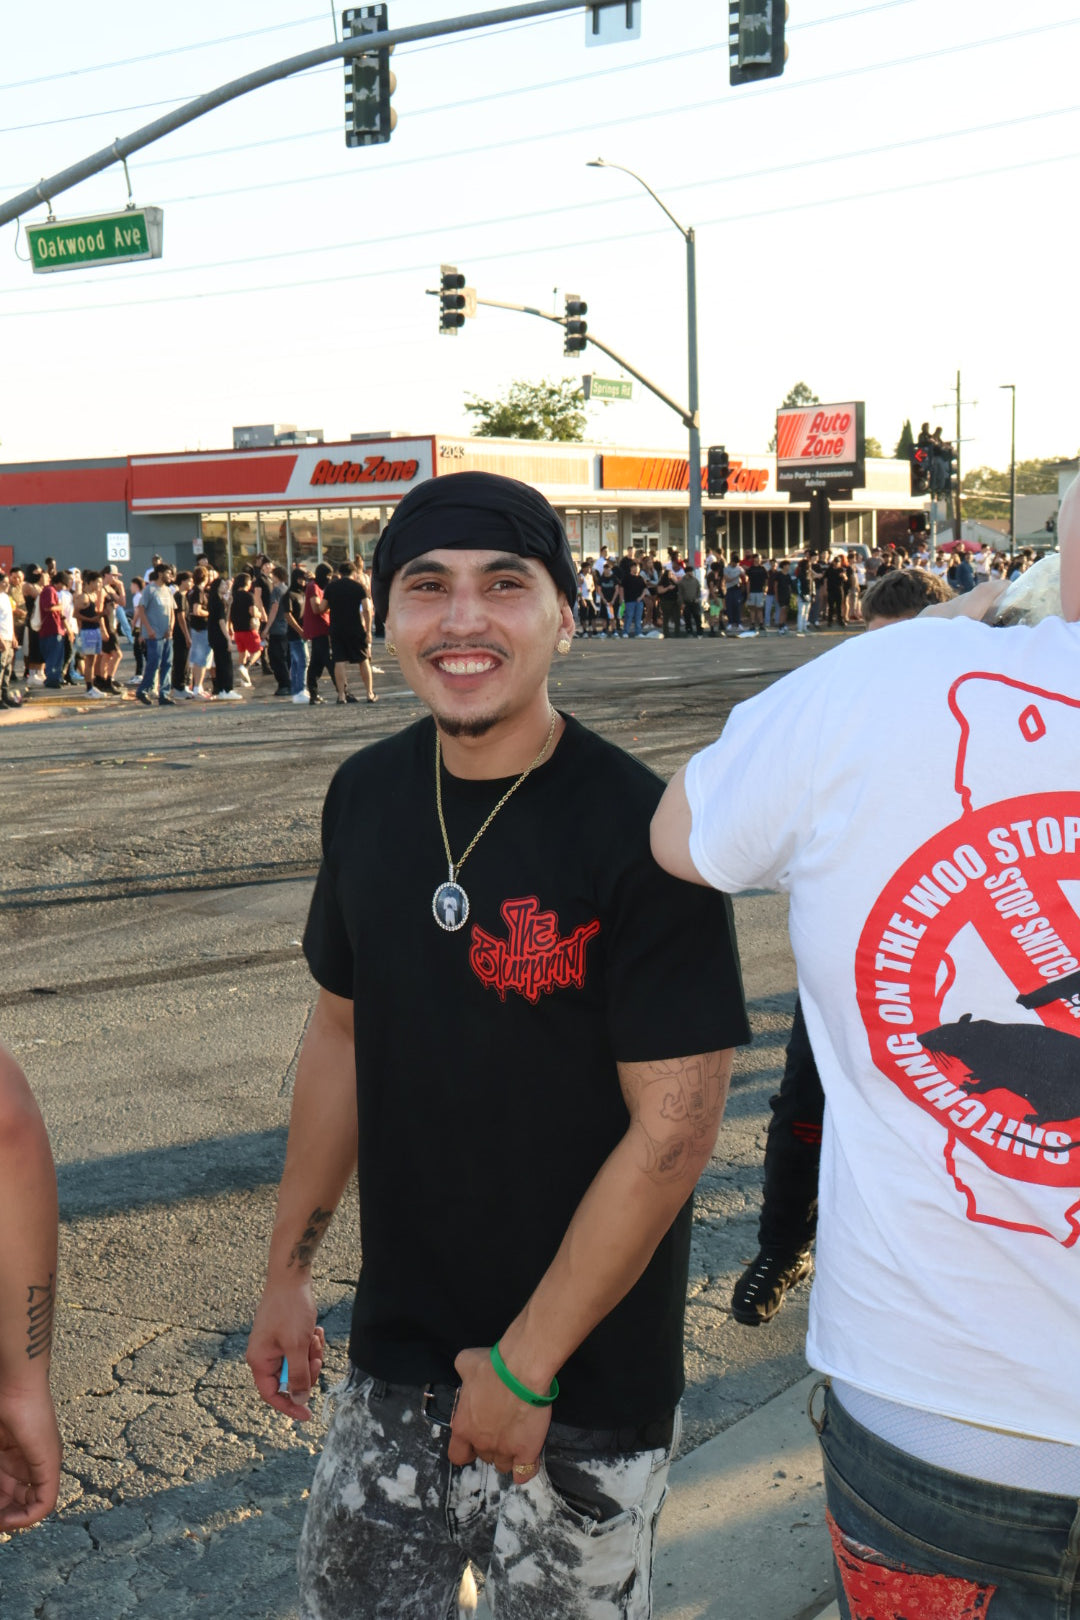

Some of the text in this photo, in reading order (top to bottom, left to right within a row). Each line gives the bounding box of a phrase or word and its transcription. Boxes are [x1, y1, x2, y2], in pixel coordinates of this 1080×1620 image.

[37, 226, 141, 259] Oakwood Ave
[592, 381, 631, 398] Springs Rd
[809, 411, 851, 434] Auto
[800, 434, 845, 457] Zone
[310, 456, 420, 486] AutoZone
[111, 548, 127, 558] 30
[983, 866, 1041, 920] STOP
[874, 816, 1080, 1165] SNITCHING ON THE WOO STOP
